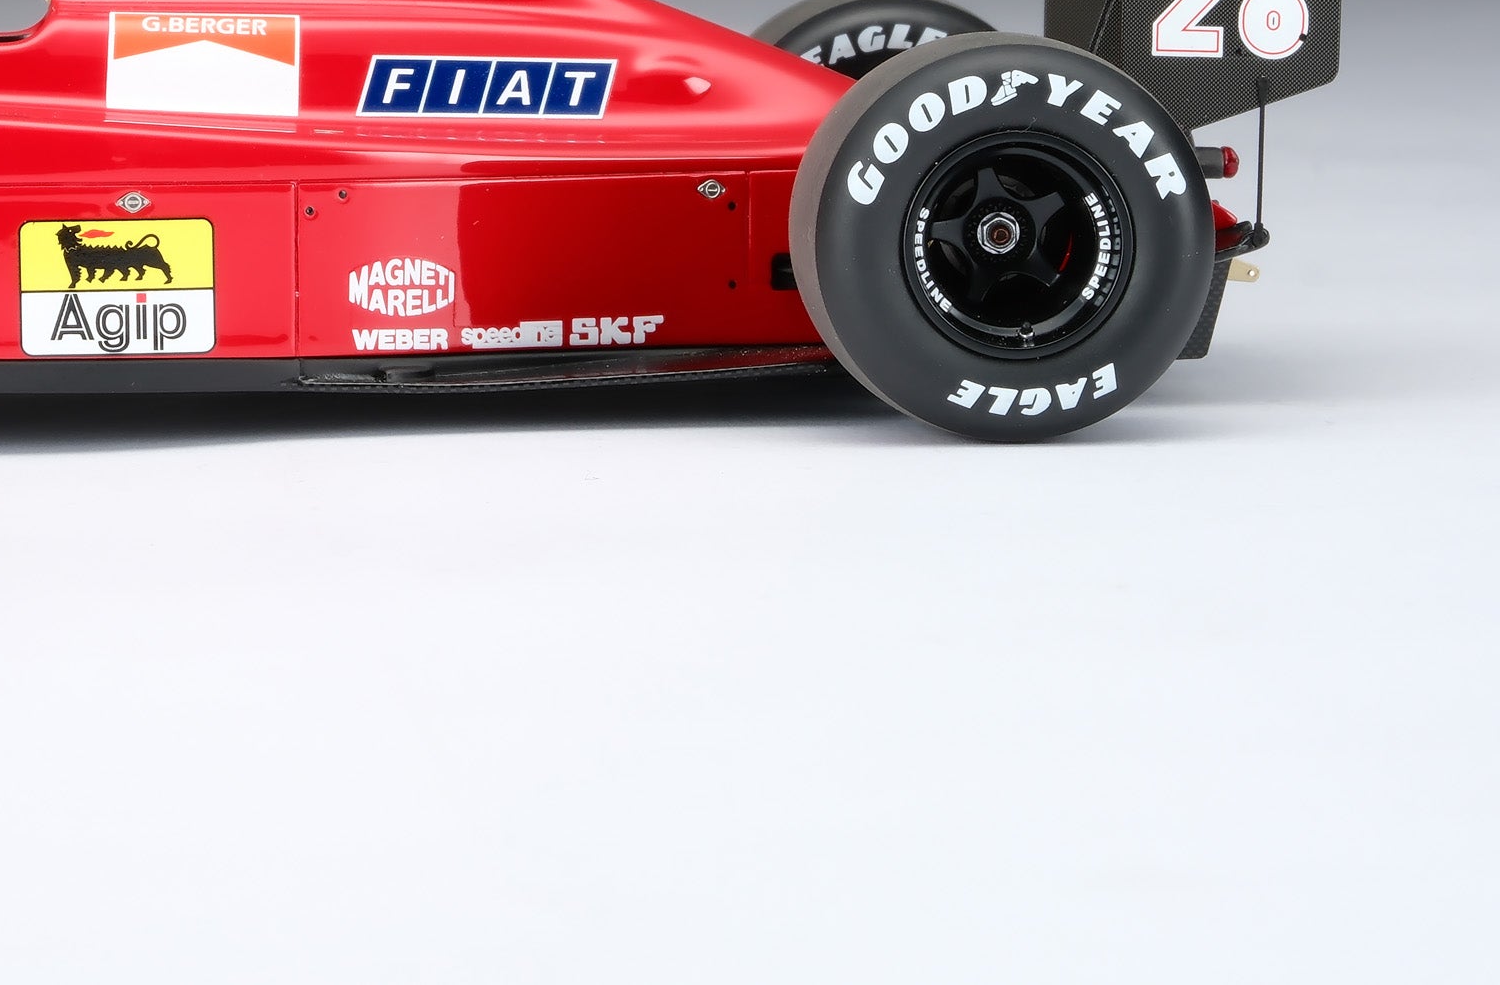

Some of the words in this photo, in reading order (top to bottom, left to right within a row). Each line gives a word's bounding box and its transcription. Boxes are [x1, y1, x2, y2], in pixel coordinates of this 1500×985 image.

[142, 16, 267, 35] G.BERGER
[383, 68, 596, 106] FIAT
[915, 207, 953, 313] SPEEDLINE
[1082, 193, 1111, 300] SPEEDLINE
[349, 258, 455, 296] MAGNETI
[349, 278, 455, 317] MARELLI
[51, 293, 187, 352] Agip
[352, 328, 449, 351] WEBER
[569, 315, 664, 346] SKF
[947, 362, 1118, 416] EAGLE
